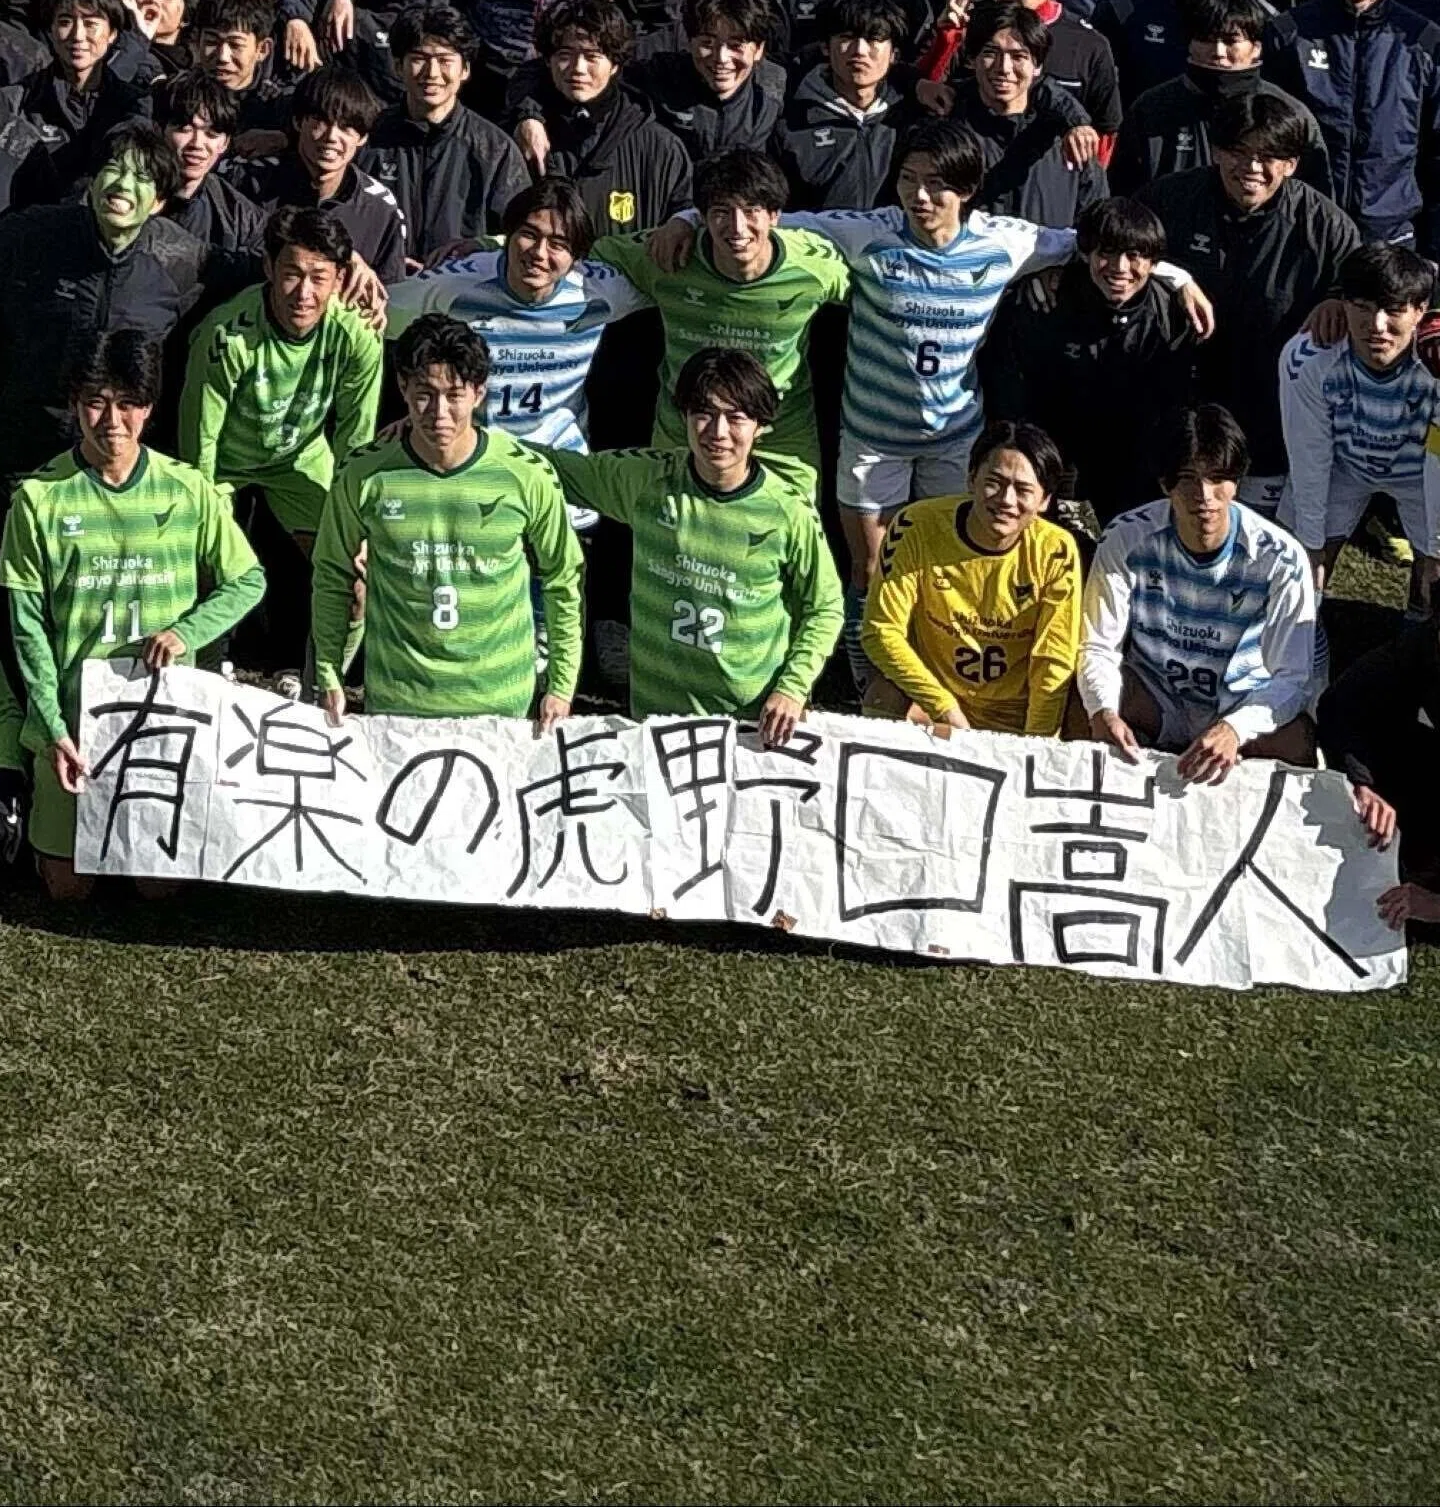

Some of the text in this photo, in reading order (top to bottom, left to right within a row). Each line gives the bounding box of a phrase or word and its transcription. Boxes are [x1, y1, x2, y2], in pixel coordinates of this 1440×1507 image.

[903, 301, 965, 318] Shizuoka
[497, 348, 556, 362] Shizuoka
[916, 340, 942, 377] 6
[497, 382, 544, 417] 14
[92, 554, 154, 571] Shizuoka
[675, 554, 737, 583] Shizuoka
[100, 599, 144, 644] 11
[432, 585, 459, 630] 8
[670, 599, 725, 654] 22
[954, 645, 1008, 683] 26
[1166, 658, 1219, 698] 29
